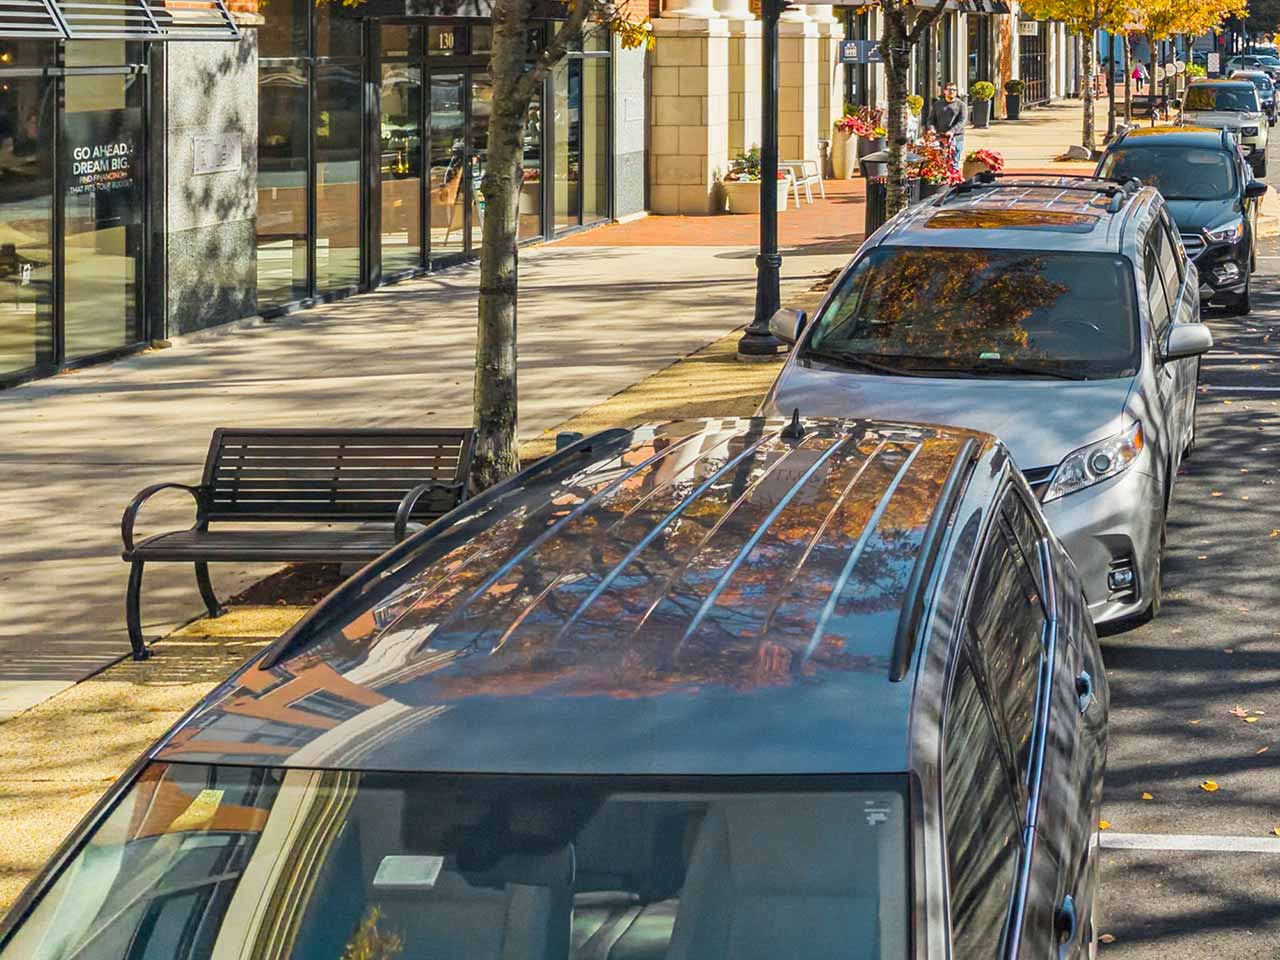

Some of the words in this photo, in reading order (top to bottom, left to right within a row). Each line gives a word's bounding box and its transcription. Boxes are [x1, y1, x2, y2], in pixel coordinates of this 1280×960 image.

[439, 32, 454, 49] 130
[73, 147, 90, 160] GO
[73, 159, 109, 175] DREAM
